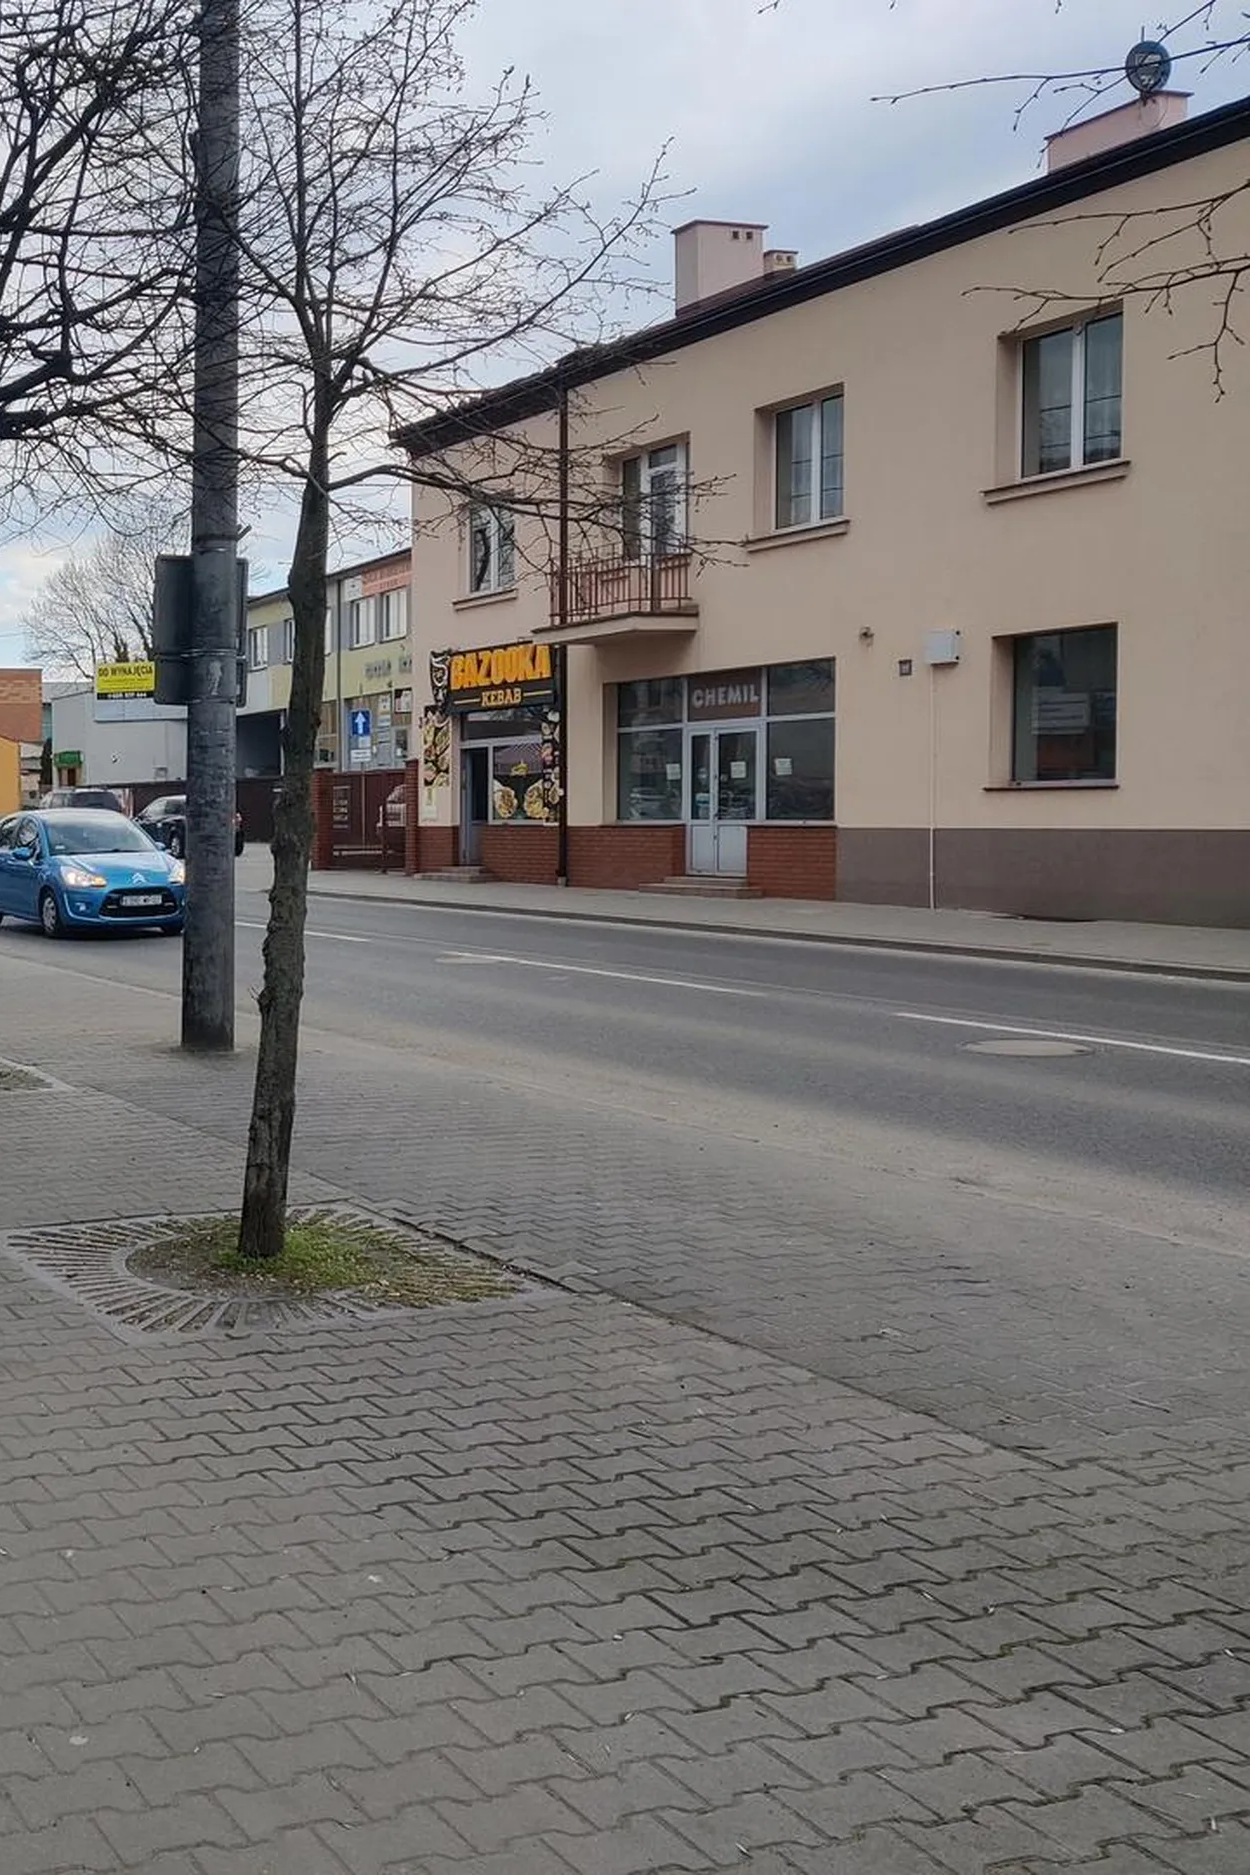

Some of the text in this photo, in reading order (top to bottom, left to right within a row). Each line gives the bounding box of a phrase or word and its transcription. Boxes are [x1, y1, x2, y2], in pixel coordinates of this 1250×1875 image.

[451, 644, 550, 690] BAZOOKA
[481, 688, 521, 707] KEBAB
[693, 684, 760, 708] CHEMIL
